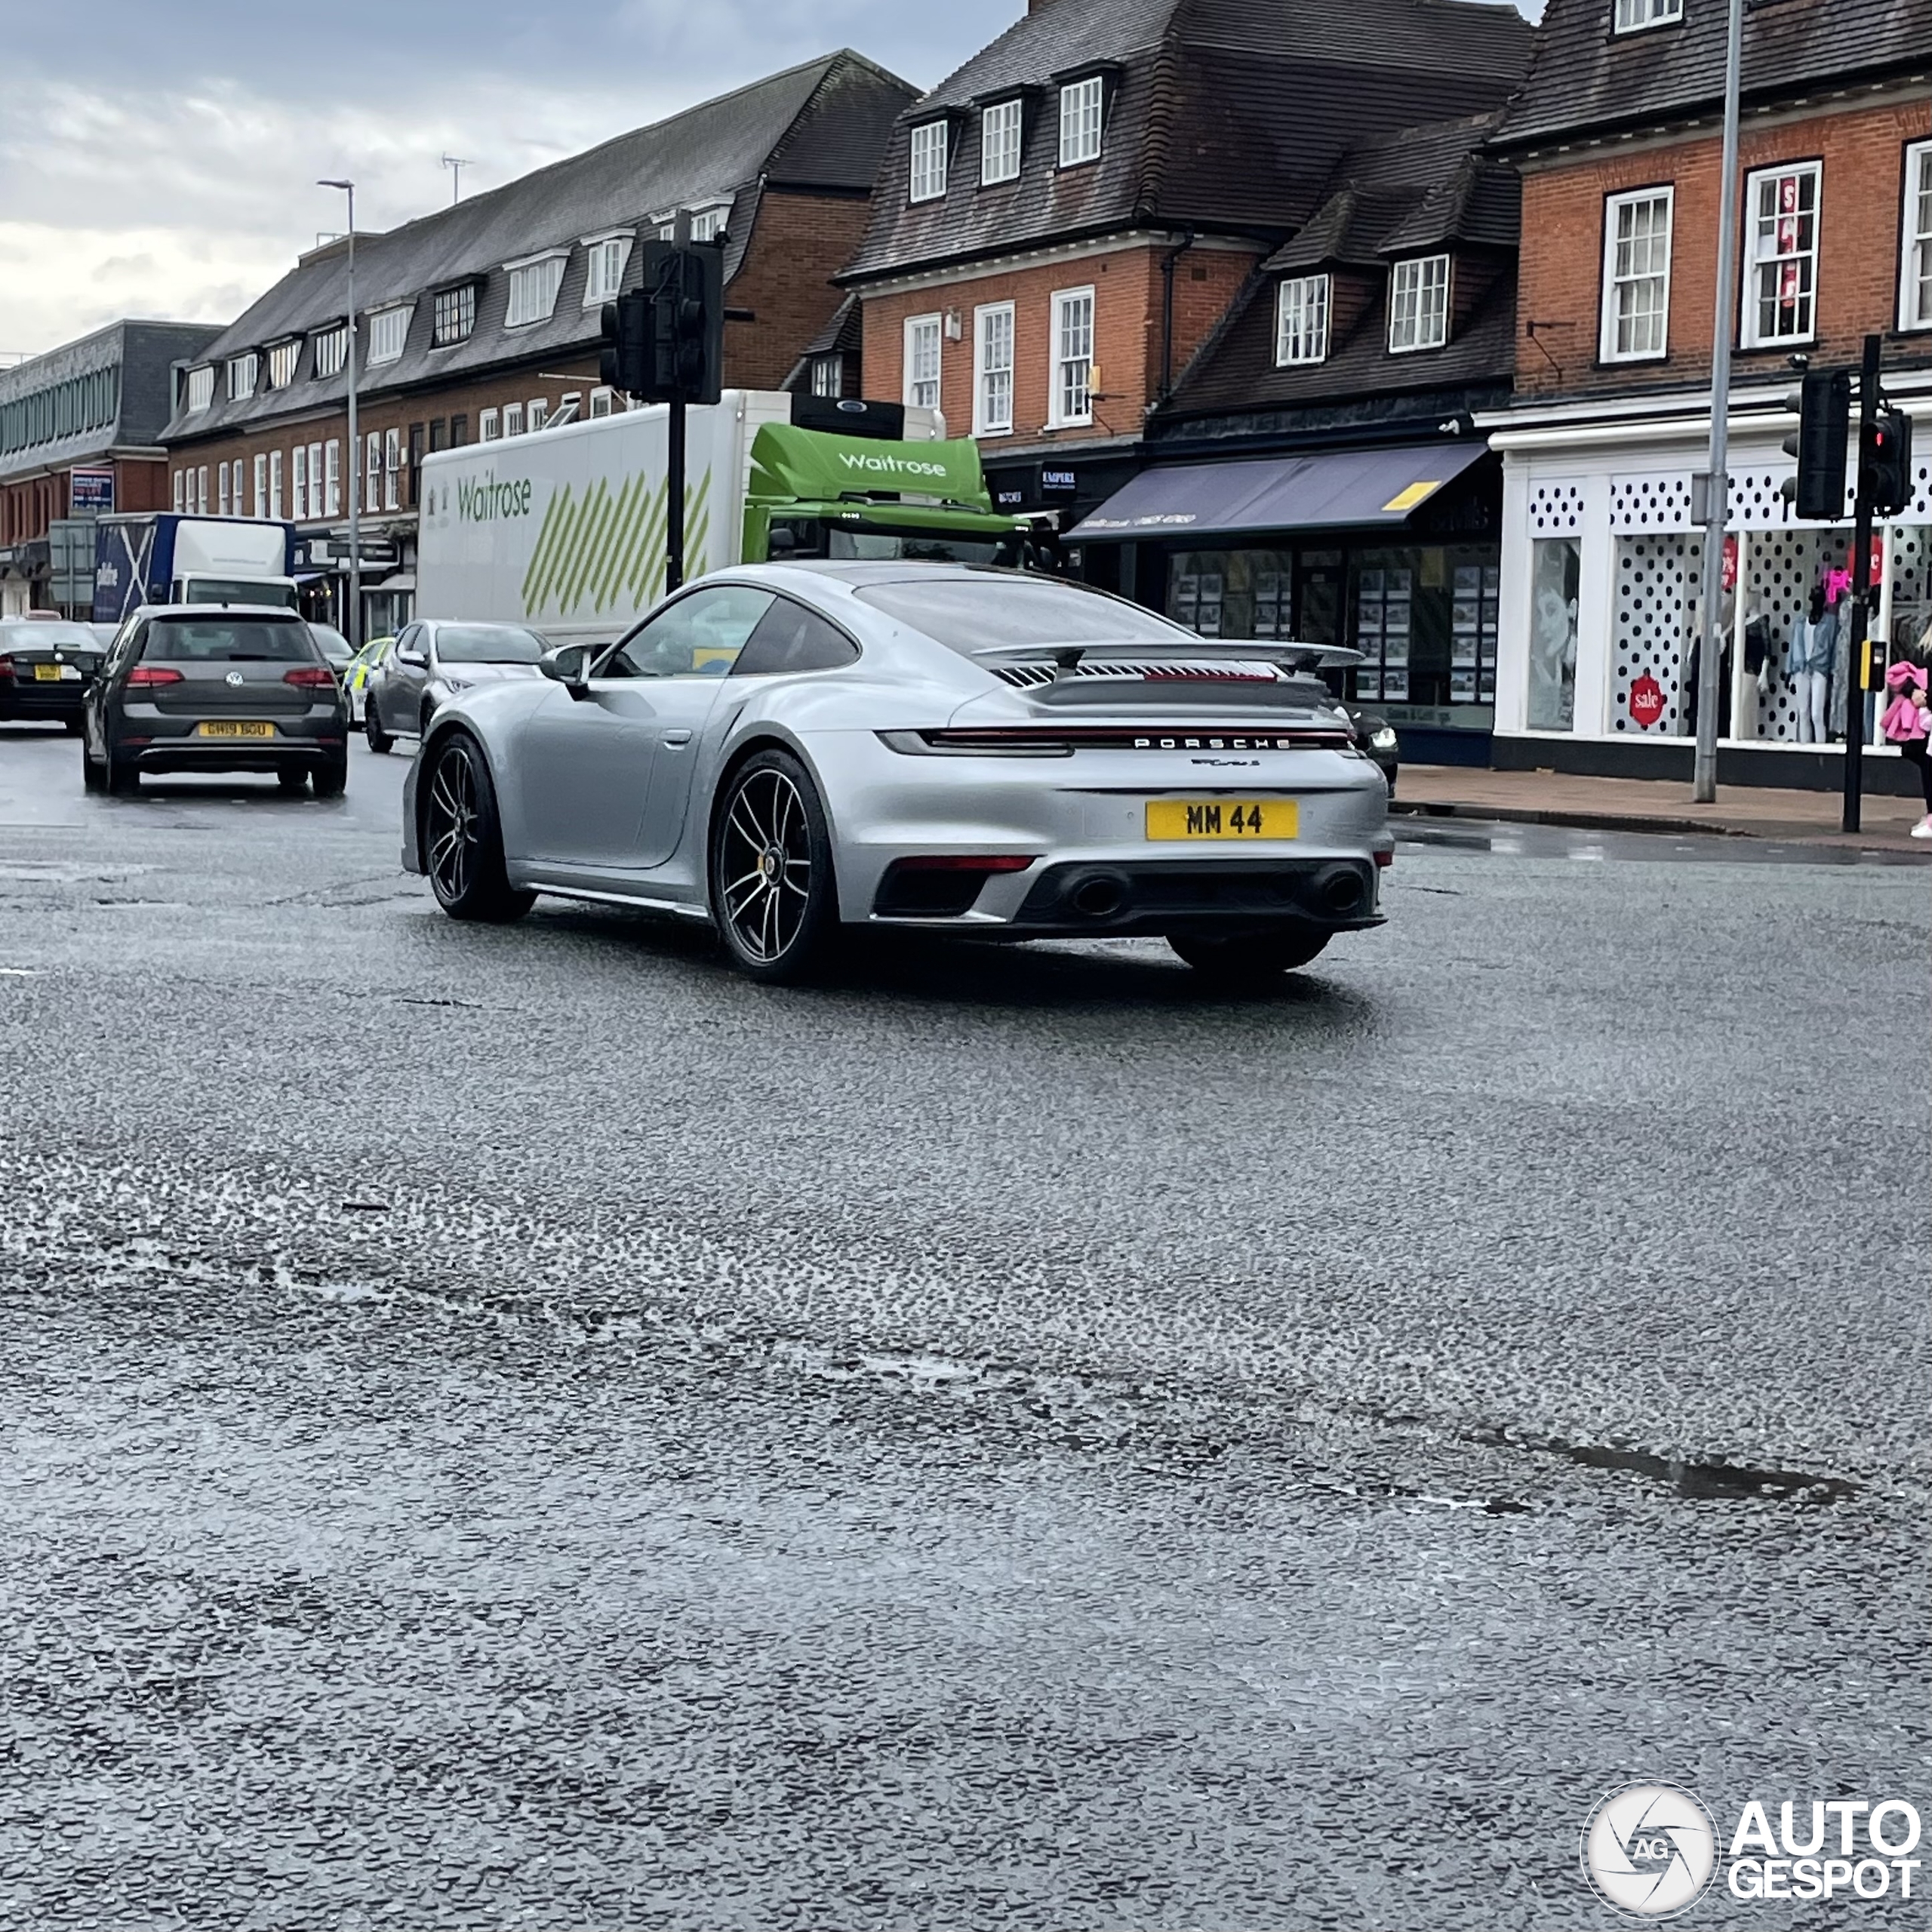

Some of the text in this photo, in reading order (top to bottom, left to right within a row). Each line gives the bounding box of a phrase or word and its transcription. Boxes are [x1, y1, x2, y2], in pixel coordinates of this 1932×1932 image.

[839, 453, 946, 477] Waitrose
[457, 468, 531, 524] Waitrose
[1635, 688, 1658, 709] sale
[1134, 738, 1290, 749] PORSCHE
[1187, 804, 1262, 834] MM 44
